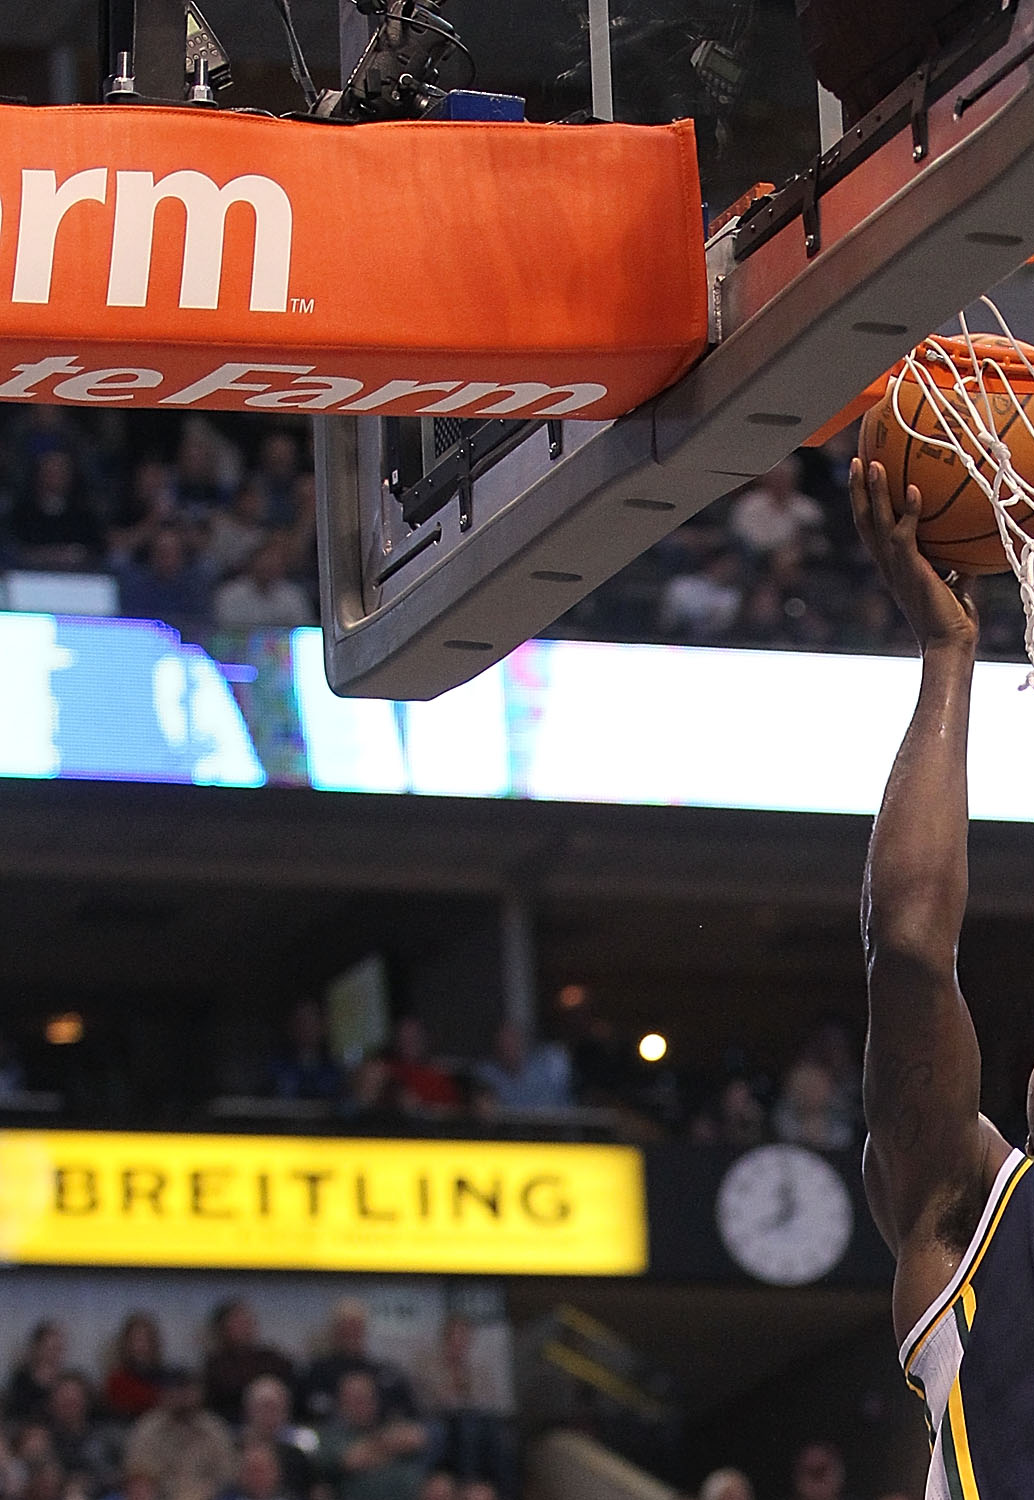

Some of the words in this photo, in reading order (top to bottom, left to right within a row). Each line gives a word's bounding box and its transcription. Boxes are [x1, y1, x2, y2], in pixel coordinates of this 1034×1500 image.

[0, 167, 293, 312] rm
[159, 363, 609, 415] Farm
[54, 1166, 574, 1226] BREITLING
